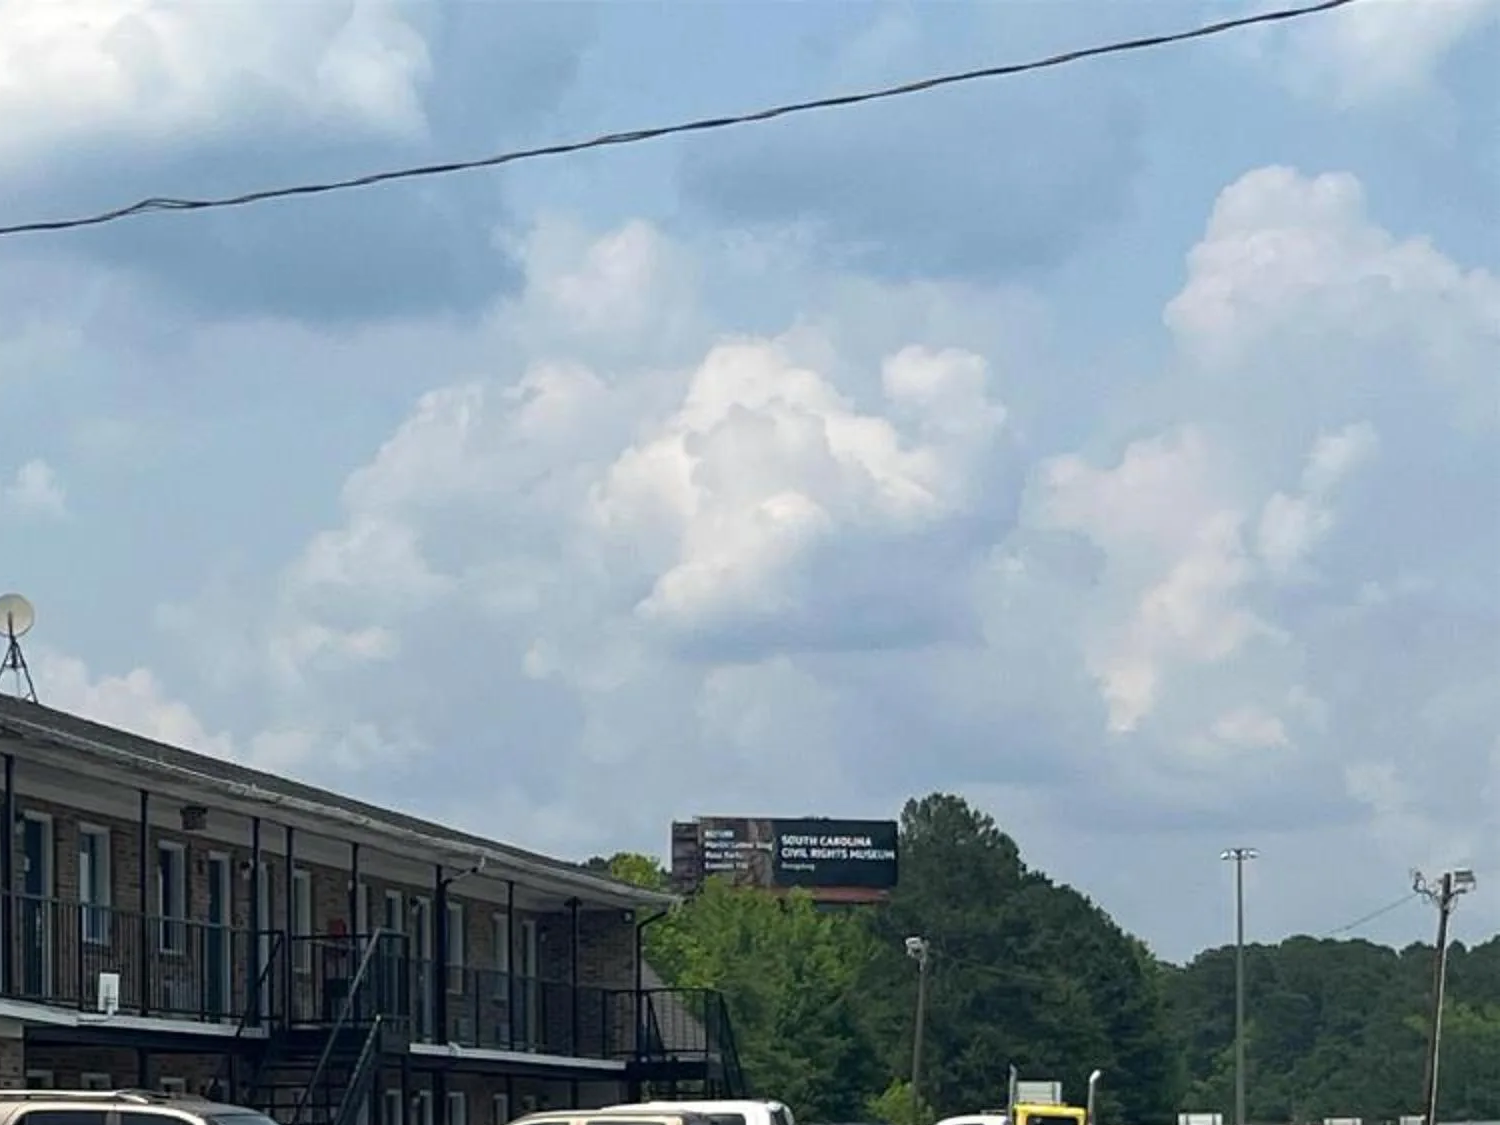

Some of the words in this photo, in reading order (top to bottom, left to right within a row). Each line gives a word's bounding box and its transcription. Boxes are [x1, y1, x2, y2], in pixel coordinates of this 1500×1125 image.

[781, 835, 817, 846] SOUTH
[820, 836, 872, 847] CAROLINA
[781, 847, 808, 859] CIVIL
[810, 848, 848, 859] RIGHTS
[850, 849, 895, 860] MUSEUM
